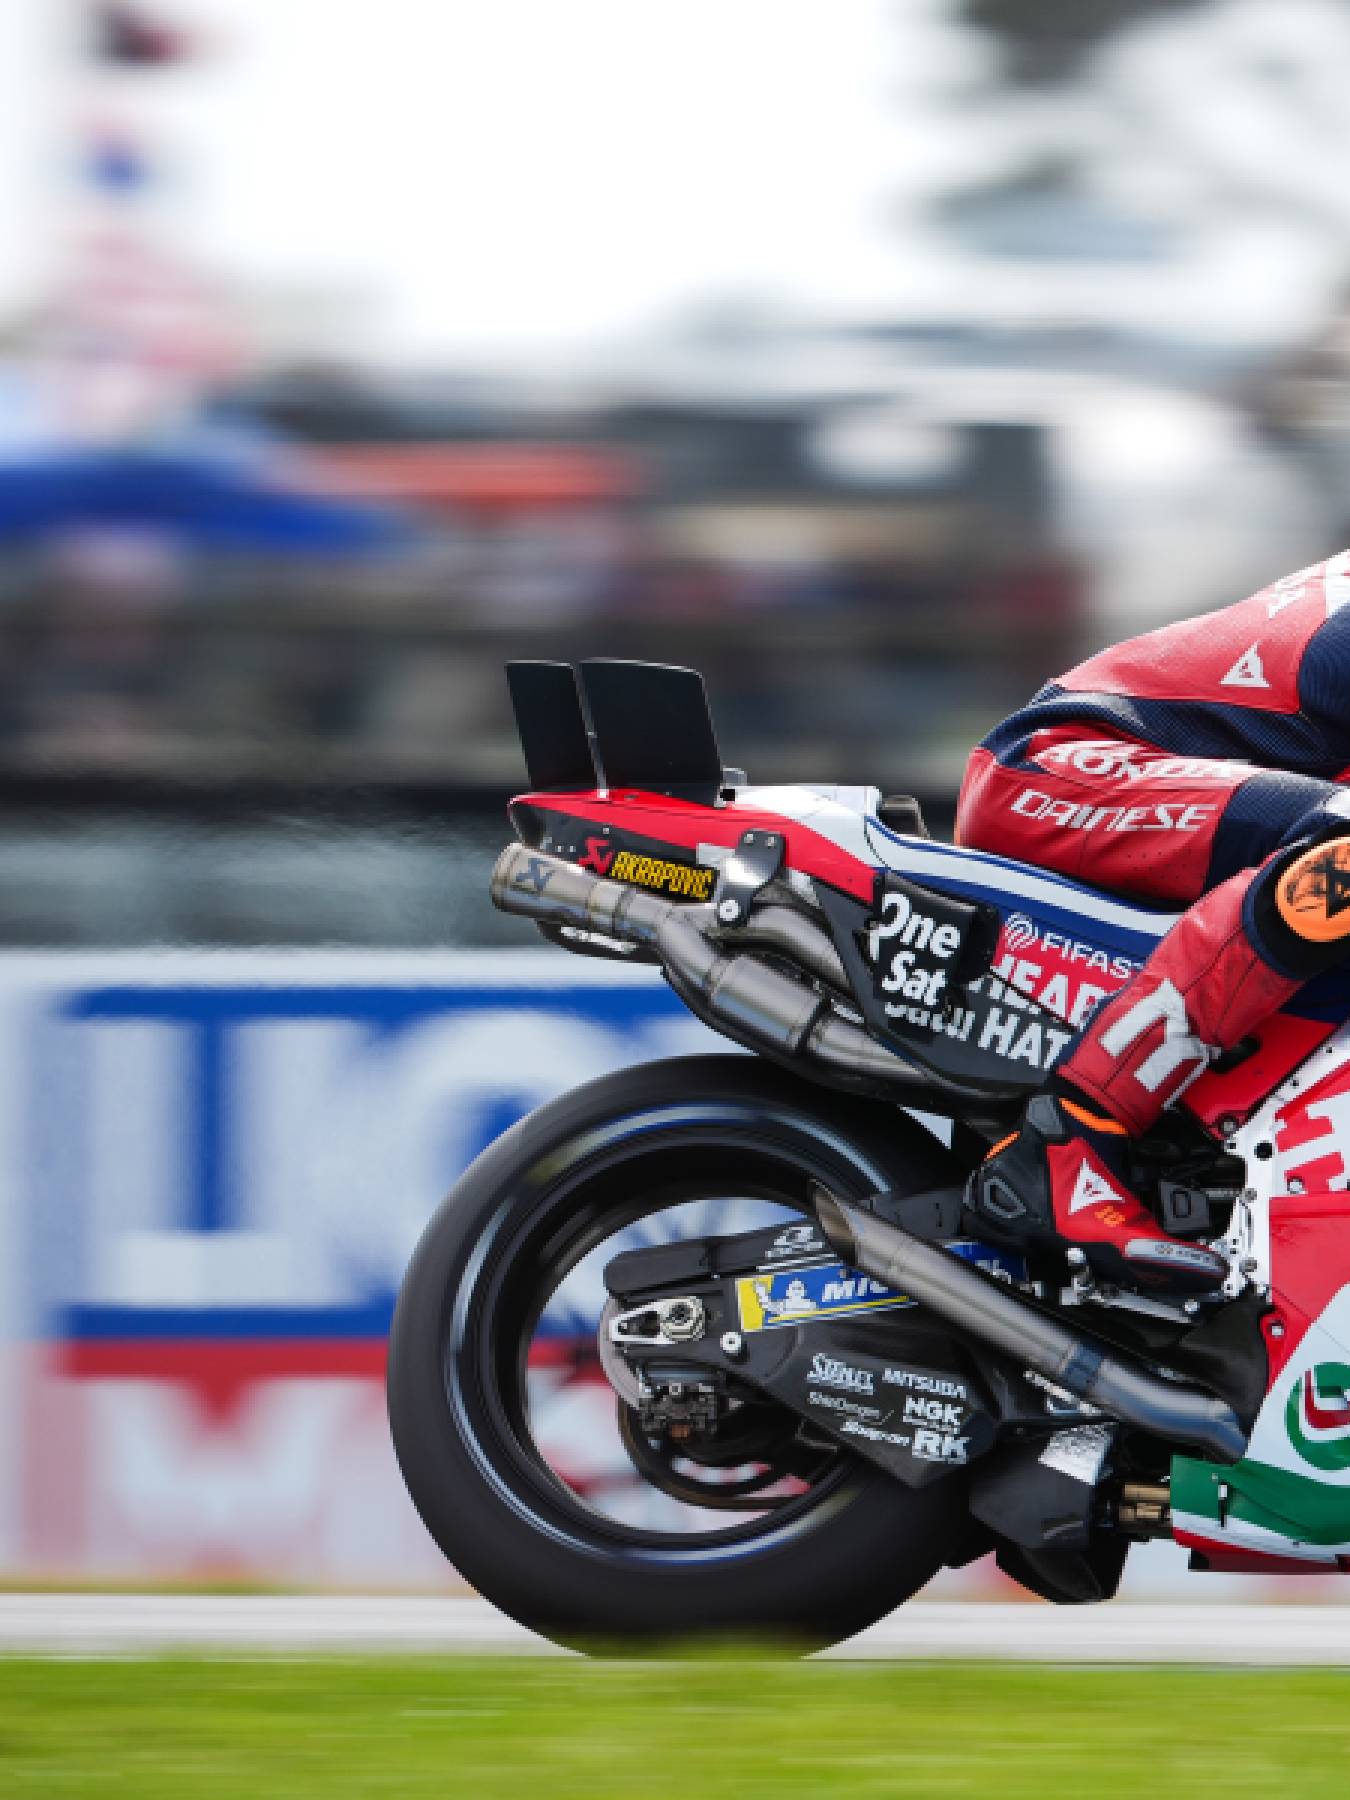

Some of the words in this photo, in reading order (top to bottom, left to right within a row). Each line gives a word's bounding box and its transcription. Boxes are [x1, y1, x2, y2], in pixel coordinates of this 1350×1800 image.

[1010, 788, 1217, 832] DAINESE
[1041, 931, 1143, 979] FIFAS
[882, 1367, 967, 1399] MITSUBA
[904, 1395, 964, 1427] NGK
[911, 1429, 972, 1460] RK
